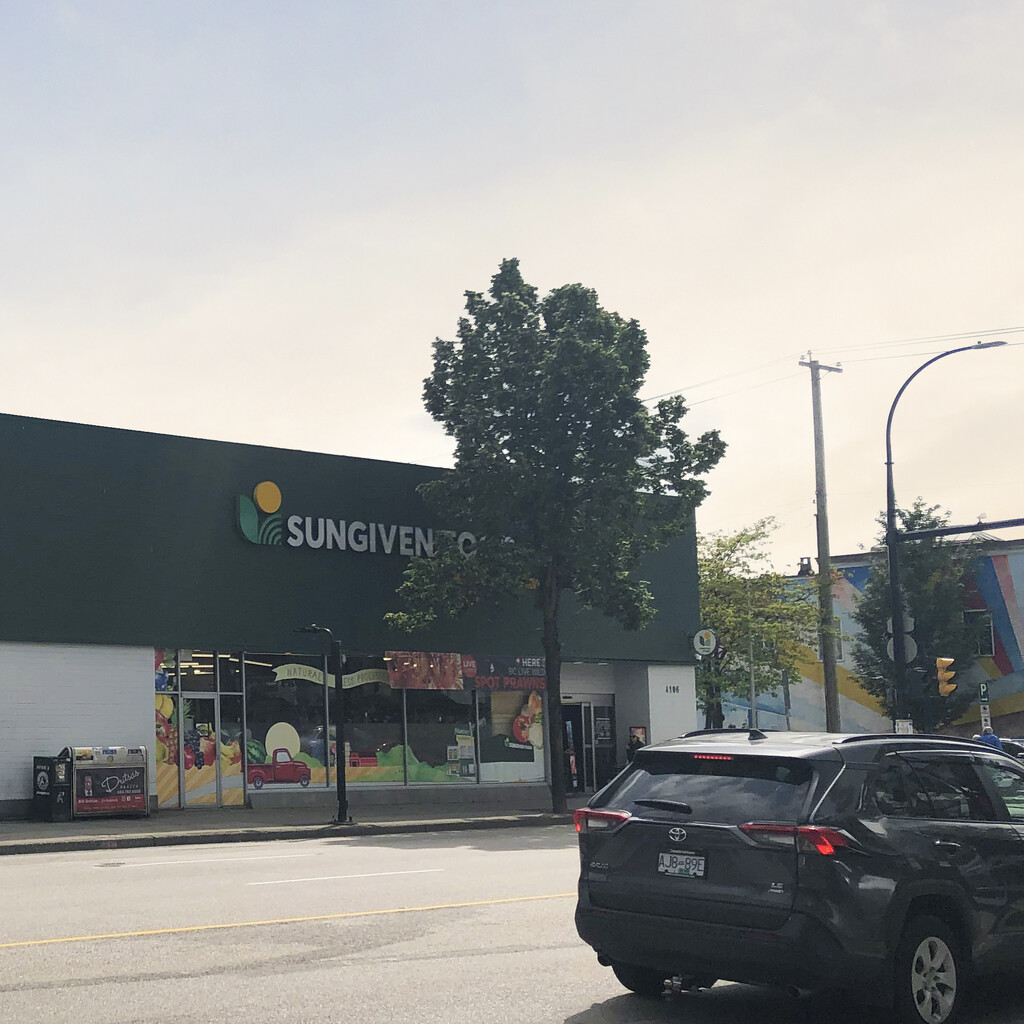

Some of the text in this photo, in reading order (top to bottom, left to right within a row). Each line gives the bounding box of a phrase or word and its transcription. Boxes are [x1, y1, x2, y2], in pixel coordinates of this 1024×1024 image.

[286, 514, 435, 558] SUNGIVEN
[521, 657, 541, 667] HERE
[286, 667, 323, 683] NATURAL
[475, 676, 546, 689] SPOT PRAWNS
[980, 683, 988, 696] P
